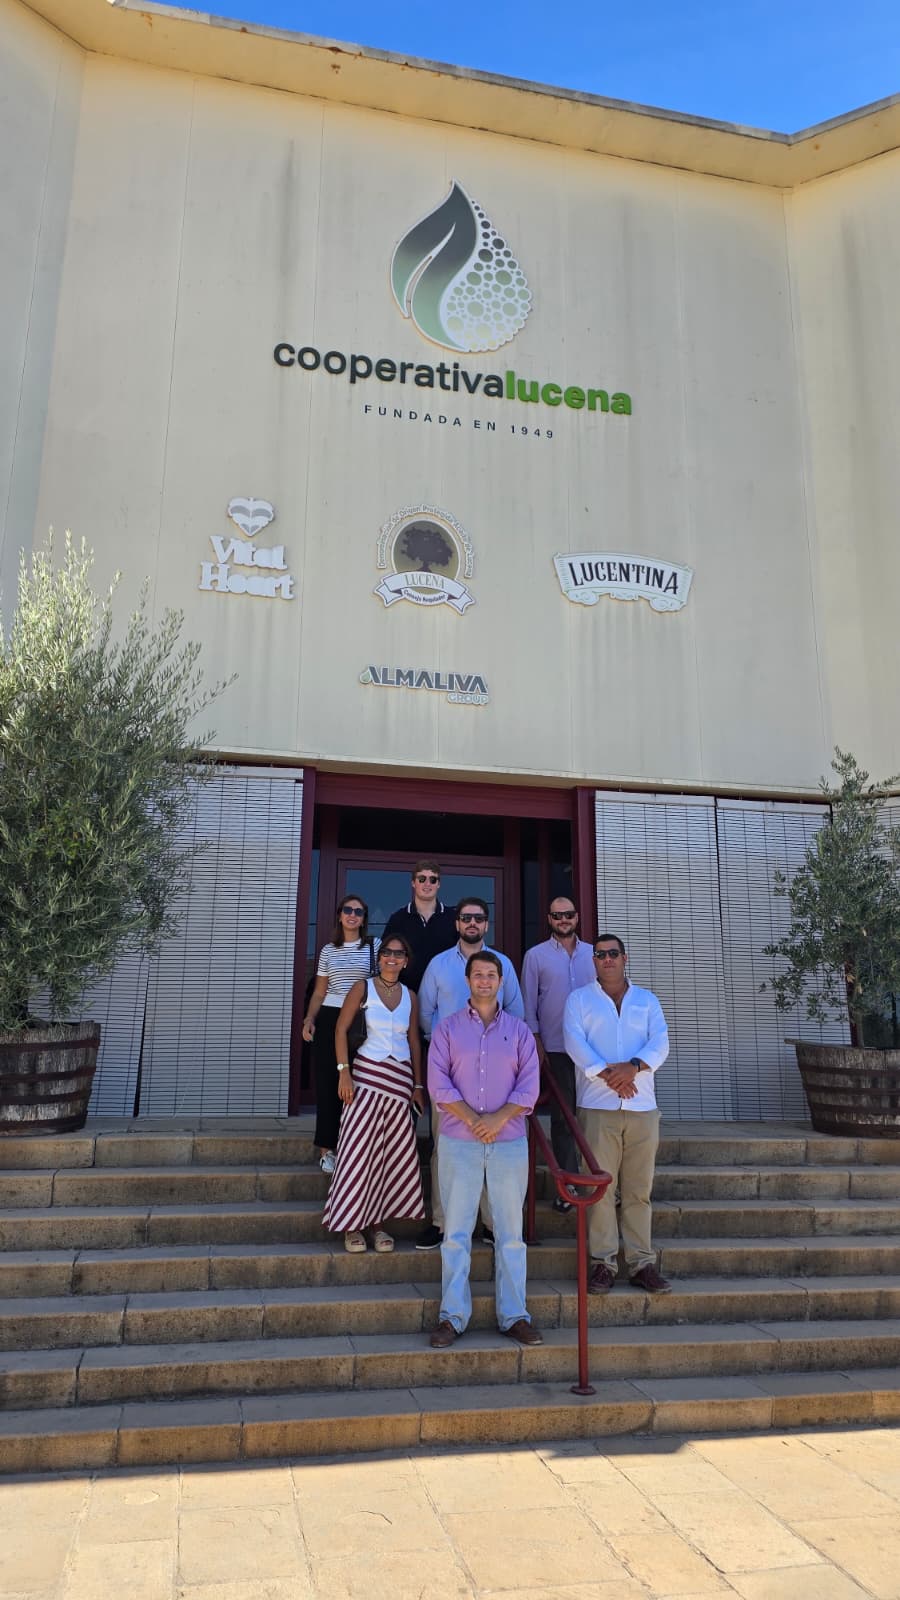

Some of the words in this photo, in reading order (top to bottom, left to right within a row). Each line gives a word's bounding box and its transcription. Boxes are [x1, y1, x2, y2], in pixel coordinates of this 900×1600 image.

[364, 404, 462, 427] FUNDADA
[474, 420, 496, 432] EN
[510, 424, 554, 439] 1949
[210, 535, 287, 569] Vital
[199, 560, 294, 599] Heart
[405, 573, 445, 588] LUCENA
[568, 561, 679, 595] LUCENTINA
[362, 665, 488, 693] ALMALIVA
[448, 692, 489, 704] GROUP
